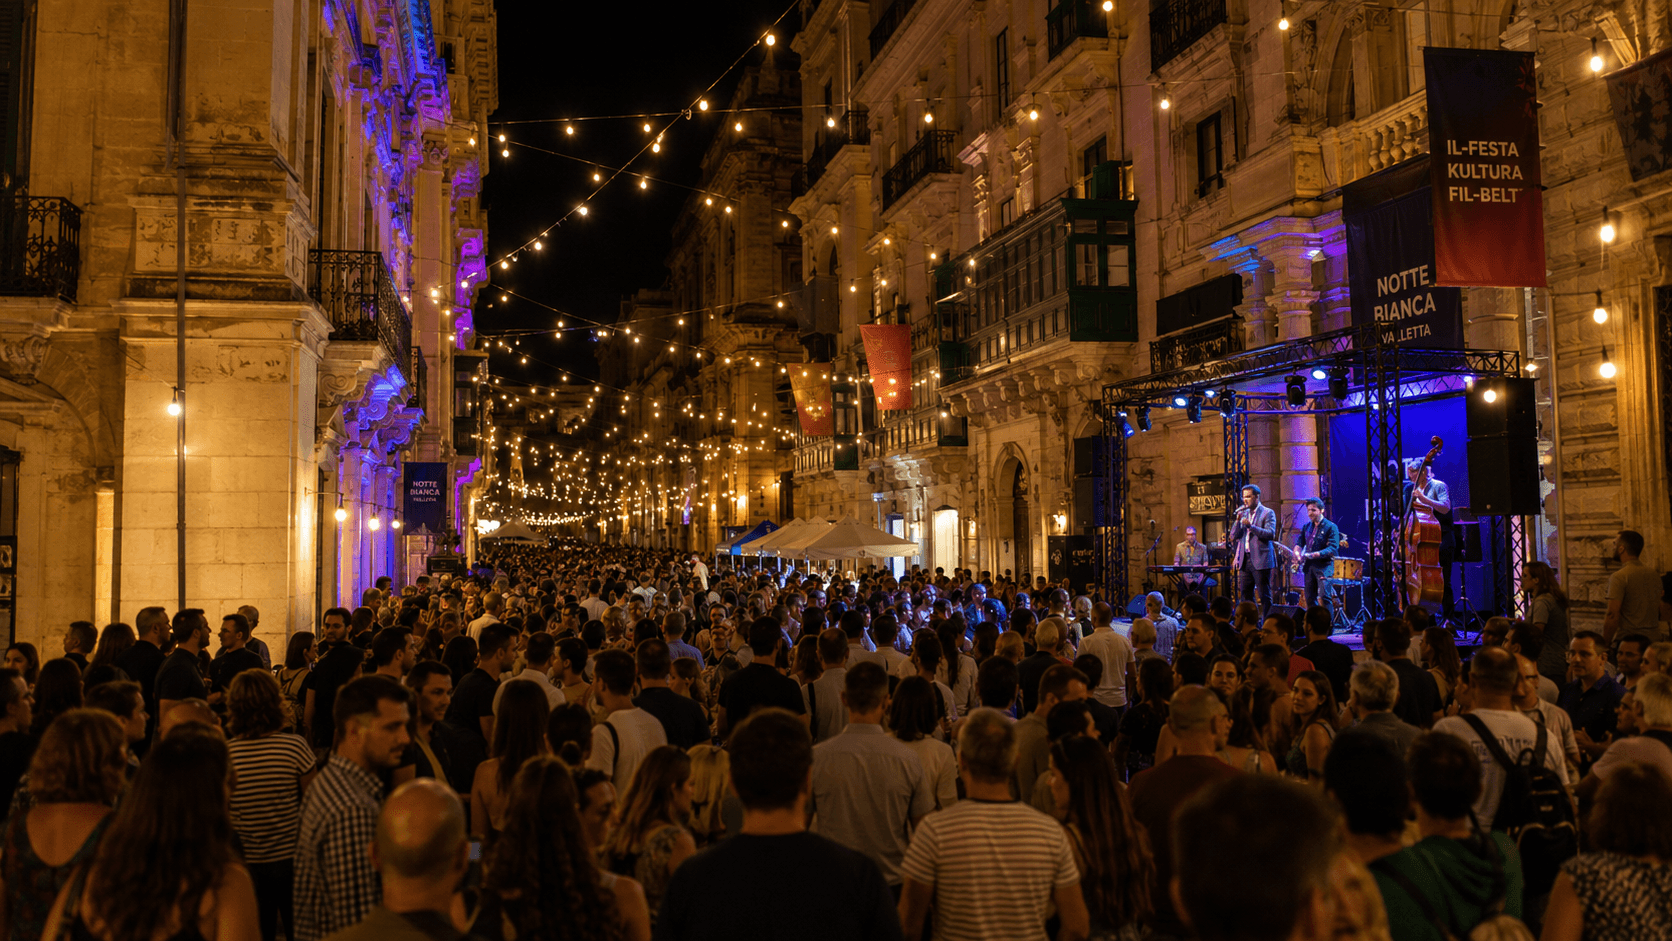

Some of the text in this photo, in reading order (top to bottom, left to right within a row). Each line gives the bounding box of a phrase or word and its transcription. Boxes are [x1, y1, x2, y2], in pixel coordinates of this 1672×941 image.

[1447, 139, 1520, 158] IL-FESTA
[1447, 162, 1524, 181] KULTURA
[1376, 264, 1430, 298] NOTTE
[1373, 292, 1437, 321] BIANCA
